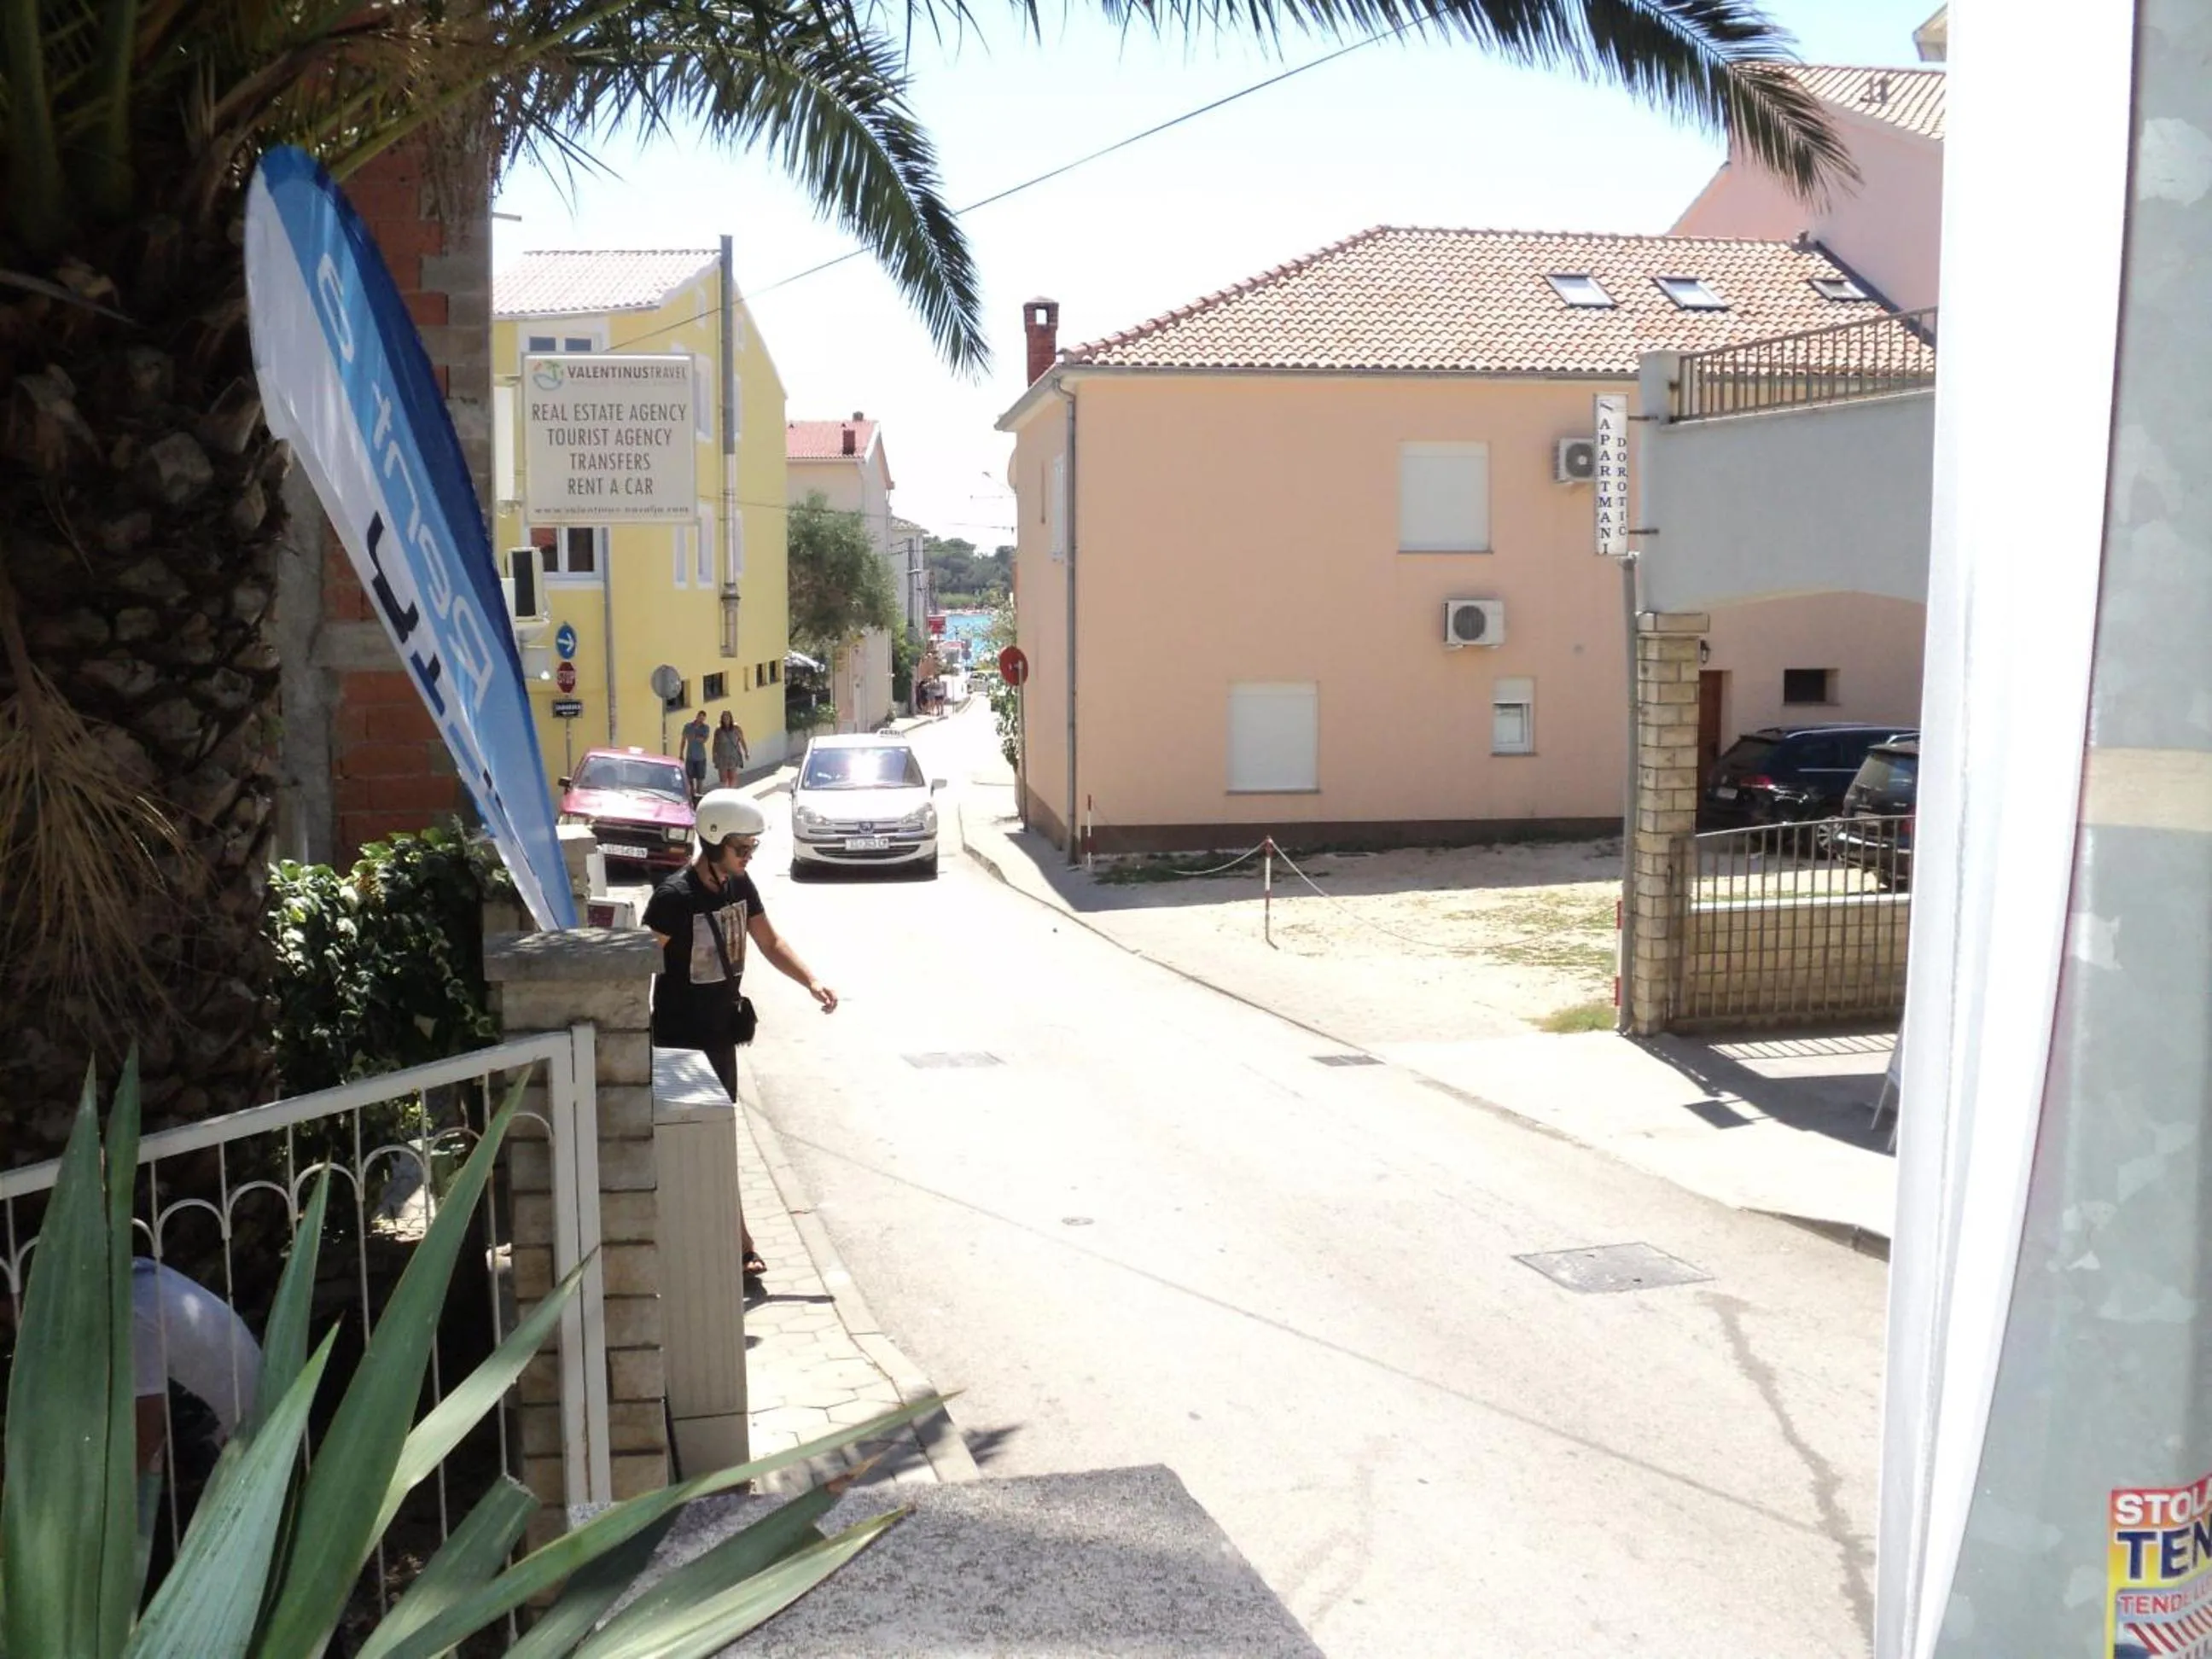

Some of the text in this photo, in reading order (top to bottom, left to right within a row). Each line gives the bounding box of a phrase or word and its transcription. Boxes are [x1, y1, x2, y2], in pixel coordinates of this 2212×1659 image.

[532, 404, 687, 422] REAL ESTATE AGENCY
[546, 428, 672, 445] TOURIST AGENCY
[570, 453, 651, 470] TRANSFERS
[568, 478, 654, 495] RENT A CAR
[1598, 418, 1613, 554] APARTMANI
